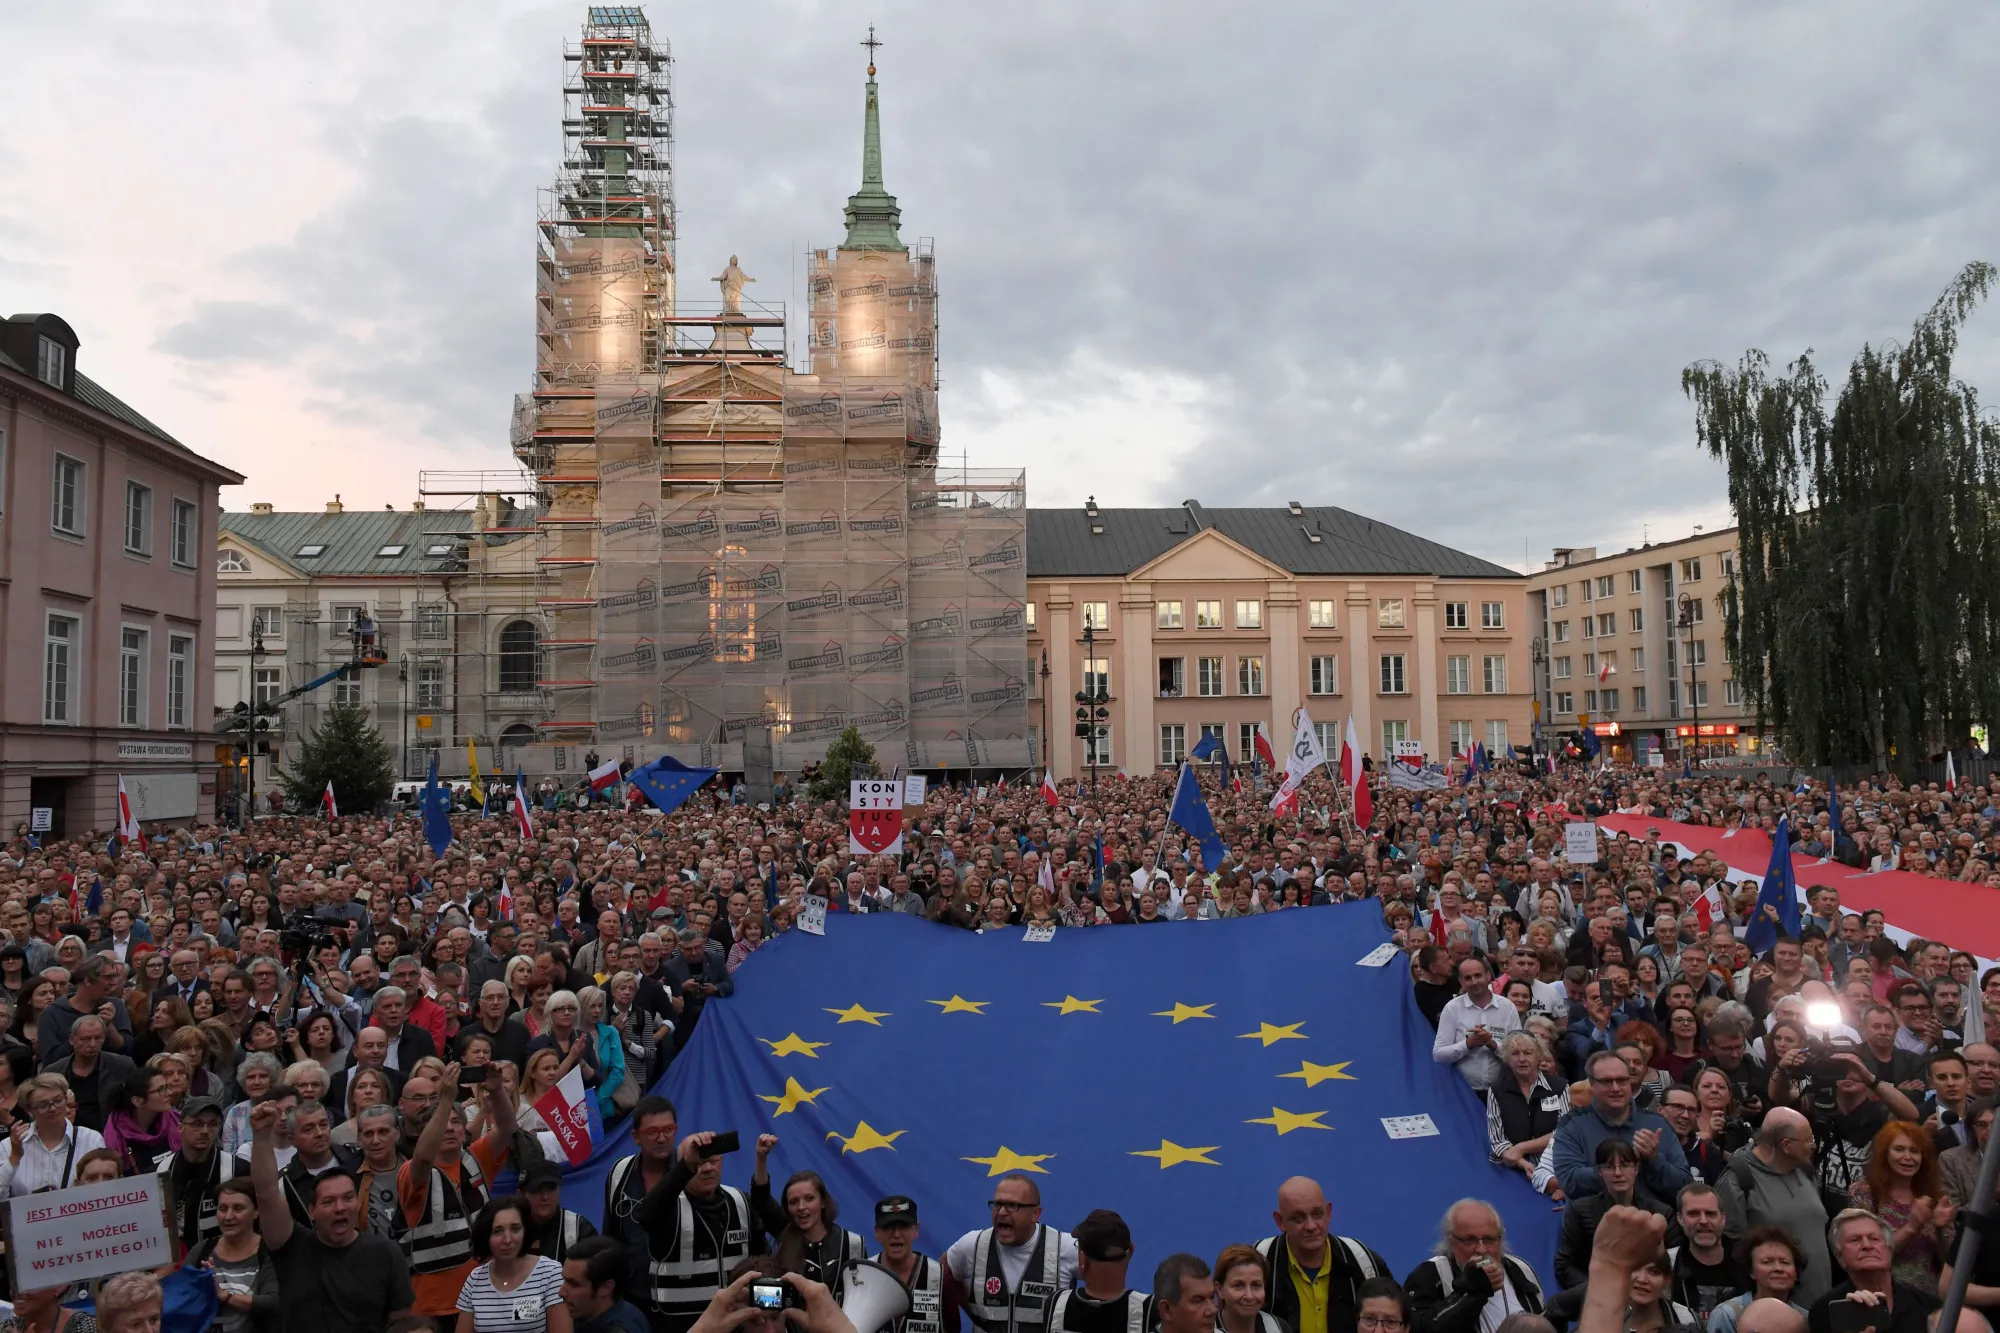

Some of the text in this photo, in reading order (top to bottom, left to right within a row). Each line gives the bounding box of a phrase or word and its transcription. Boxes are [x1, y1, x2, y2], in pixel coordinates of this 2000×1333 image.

[842, 285, 884, 298] remmers
[842, 336, 885, 350] remmers
[598, 400, 648, 420] remmers
[787, 402, 838, 417] remmers
[849, 403, 898, 419] remmers
[787, 459, 836, 474] remmers
[849, 460, 897, 470] remmers
[602, 515, 651, 536] remmers
[662, 520, 714, 538] remmers
[725, 517, 777, 533] remmers
[787, 520, 837, 536] remmers
[849, 519, 899, 531] remmers
[662, 580, 714, 597] remmers
[601, 590, 653, 608] remmers
[787, 594, 840, 612] remmers
[849, 591, 898, 606] remmers
[970, 614, 1018, 630] remmers
[601, 649, 651, 667] remmers
[662, 642, 714, 661] remmers
[849, 650, 899, 666] remmers
[788, 652, 840, 670] remmers
[910, 685, 958, 702] remmers
[971, 687, 1020, 703] remmers
[790, 716, 840, 733] remmers
[849, 711, 901, 727] remmers
[859, 783, 895, 793] KON
[859, 797, 894, 808] STY
[859, 811, 893, 822] TUC
[859, 825, 881, 836] JA
[1569, 830, 1591, 838] PAD
[803, 896, 825, 908] KON
[801, 914, 821, 926] TUC
[1387, 1115, 1426, 1123] KON
[549, 1105, 580, 1150] POLSKA
[26, 1190, 149, 1223] JEST KONSTYTUCJA
[36, 1222, 139, 1250] NIE MOŻECIE
[32, 1236, 158, 1271] WSZYSTKIEGO!!
[908, 1321, 937, 1333] POLSKA
